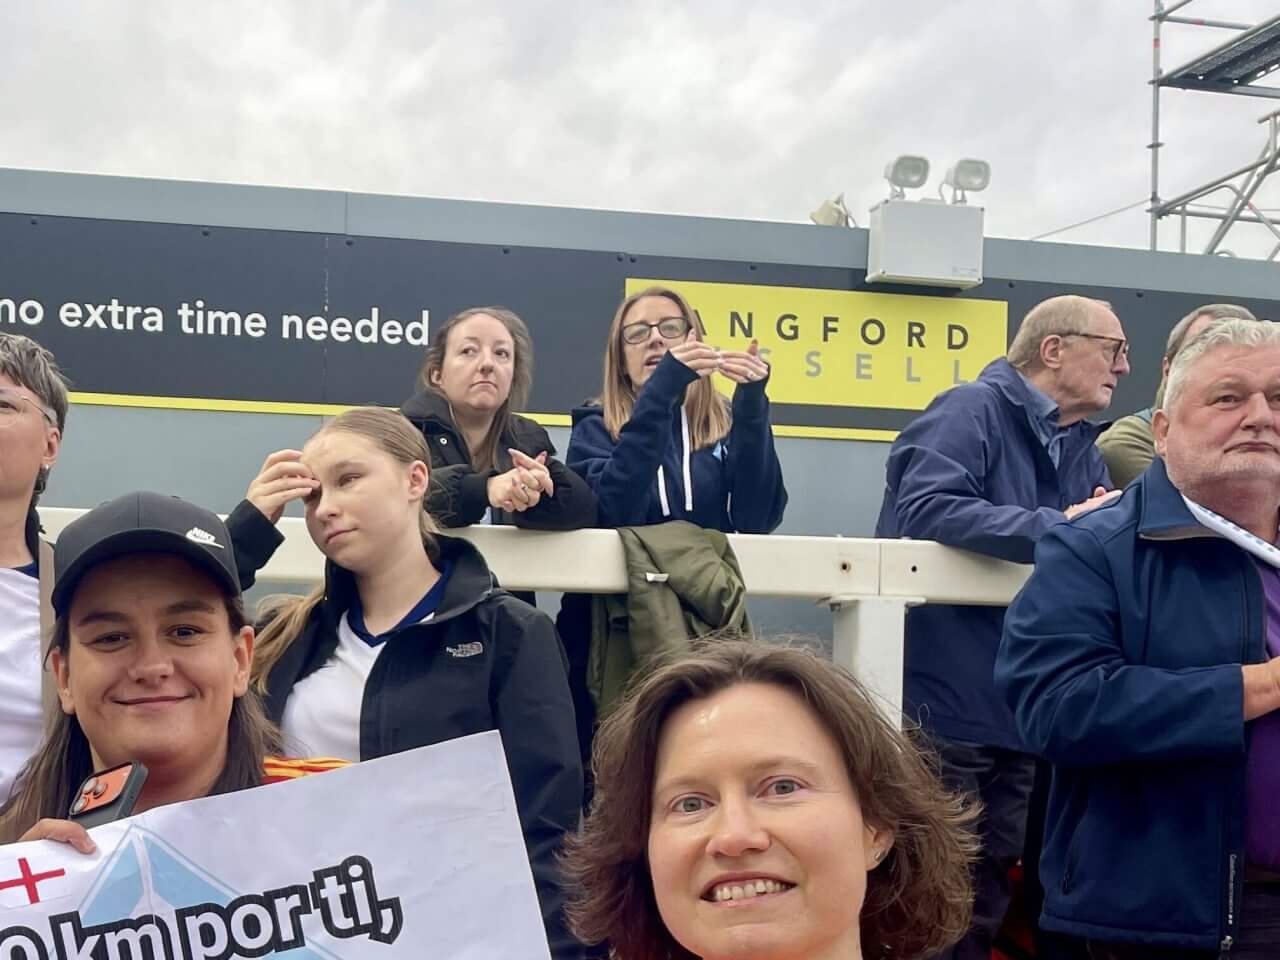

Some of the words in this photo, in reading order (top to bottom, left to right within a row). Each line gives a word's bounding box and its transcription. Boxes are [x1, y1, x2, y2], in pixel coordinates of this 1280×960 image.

[59, 298, 164, 333] extra
[177, 300, 267, 338] time
[282, 307, 431, 347] needed
[694, 308, 970, 351] NGFORD
[756, 345, 972, 385] SELL
[308, 854, 404, 946] ti,
